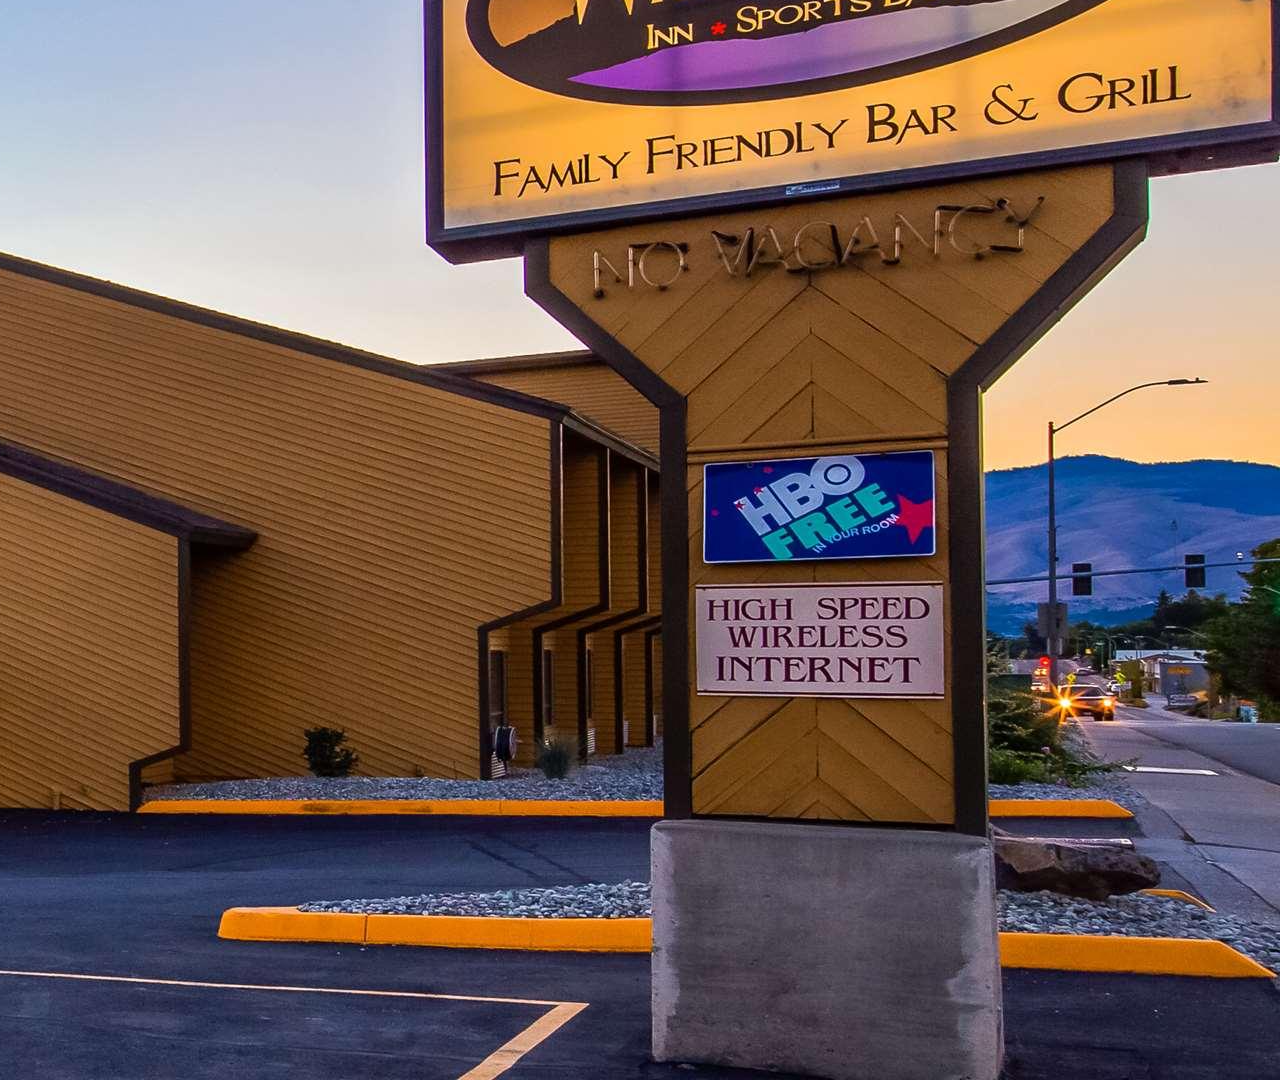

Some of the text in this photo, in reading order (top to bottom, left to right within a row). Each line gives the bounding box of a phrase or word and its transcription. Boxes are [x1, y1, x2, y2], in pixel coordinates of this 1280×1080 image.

[646, 22, 694, 50] INN
[493, 65, 1192, 198] FAMILY FRIENDLY BAR & GRILL
[593, 197, 1045, 297] NO VACANCY
[733, 456, 866, 537] HBO
[761, 482, 896, 561] FREE
[812, 512, 901, 554] IN YOUR ROOM
[707, 597, 931, 621] HIGH SPEED
[727, 625, 909, 648] WIRELESS
[716, 655, 922, 683] INTERNET
